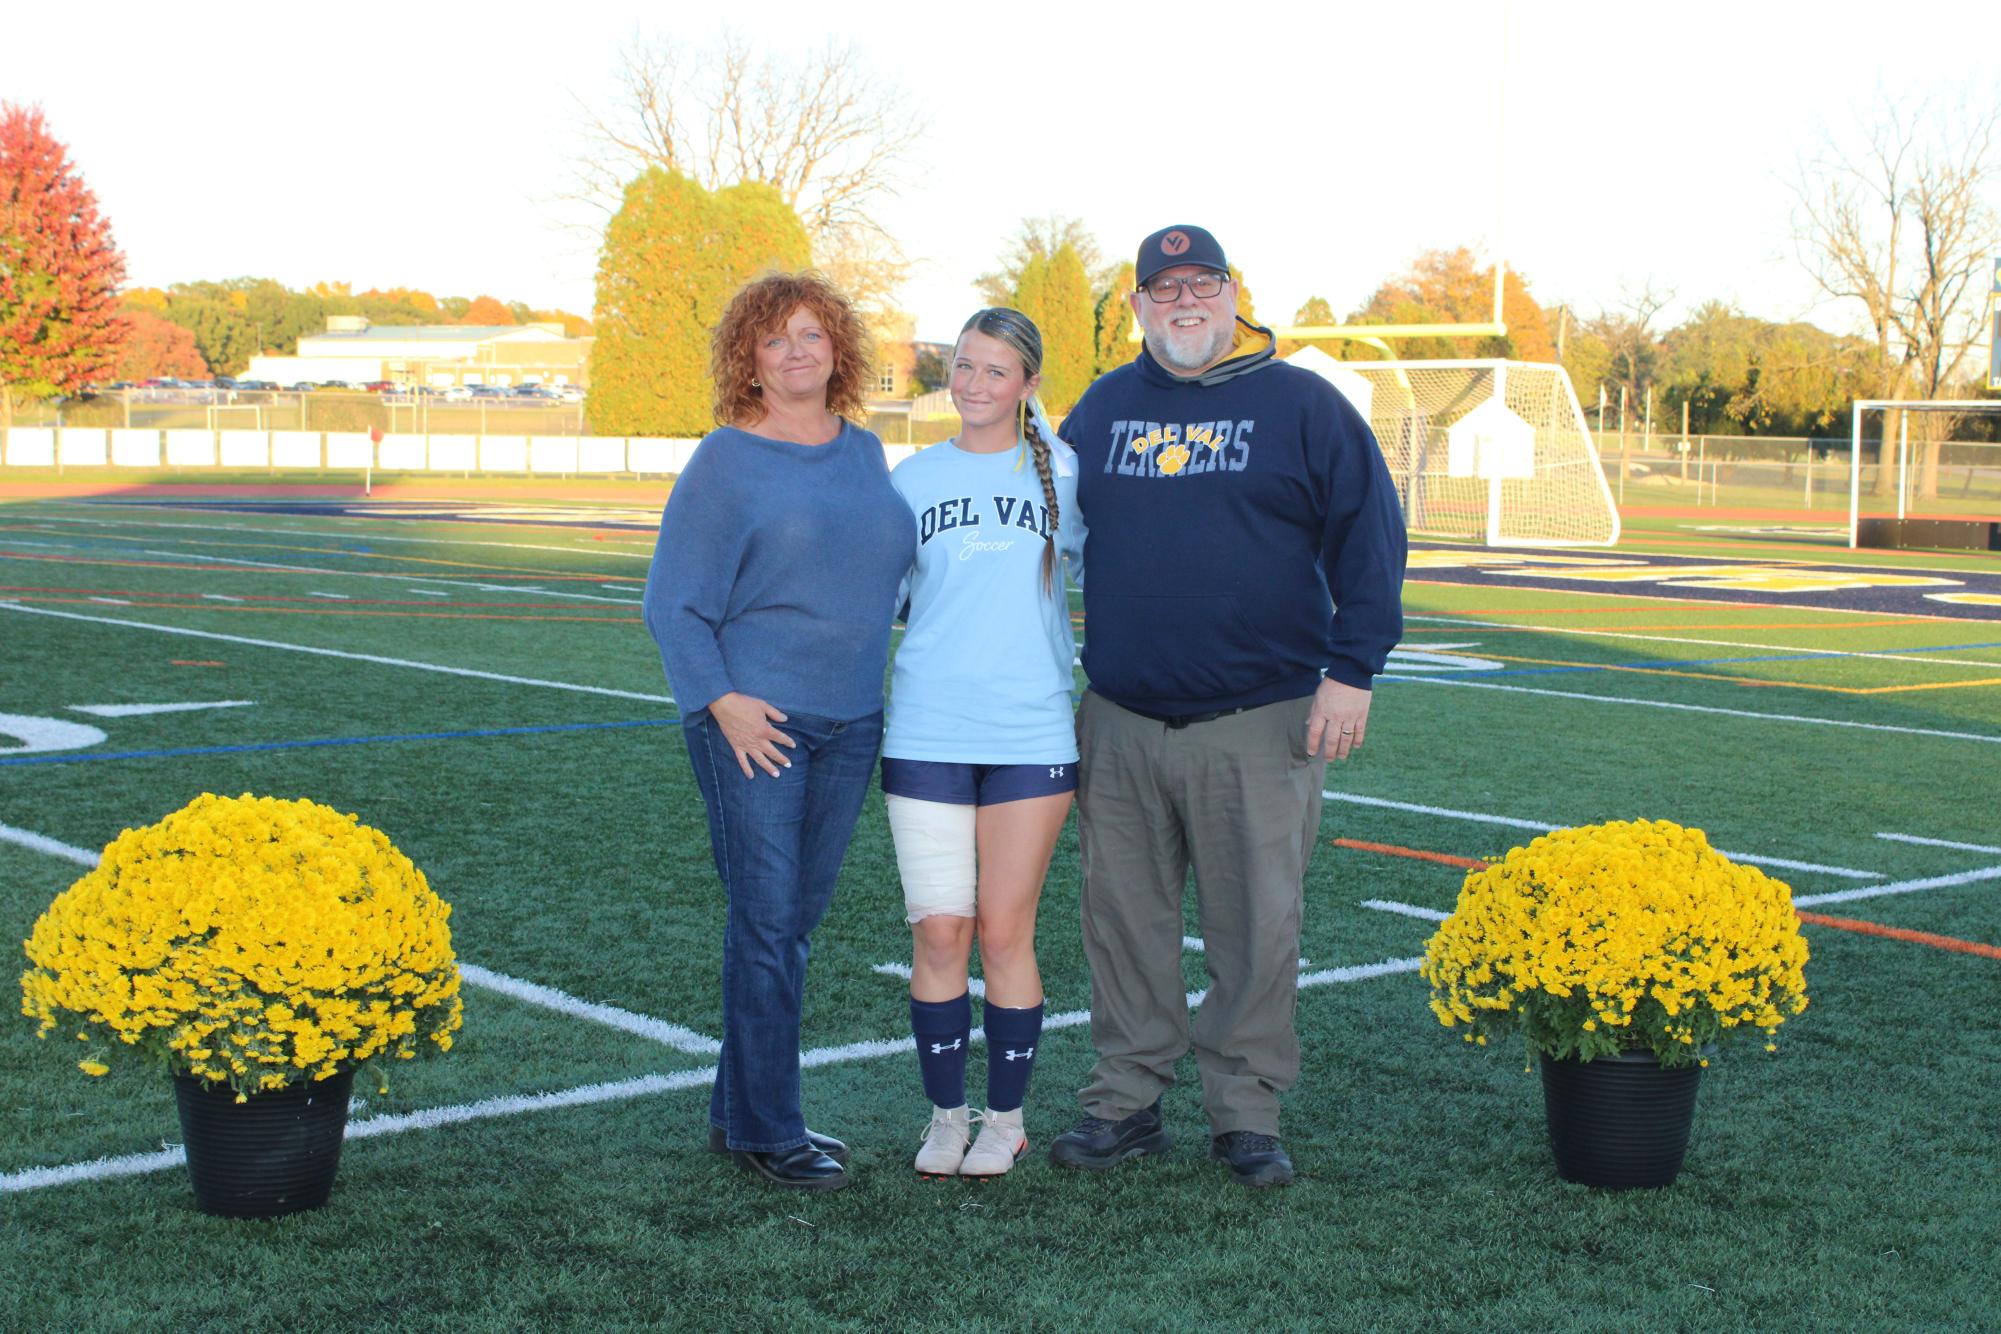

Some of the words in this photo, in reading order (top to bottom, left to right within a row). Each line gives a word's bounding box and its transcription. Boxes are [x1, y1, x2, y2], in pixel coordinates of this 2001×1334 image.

[1131, 426, 1177, 455] DEL
[1186, 425, 1224, 453] VAL
[920, 497, 980, 546] DEL
[959, 530, 1014, 560] Soccer
